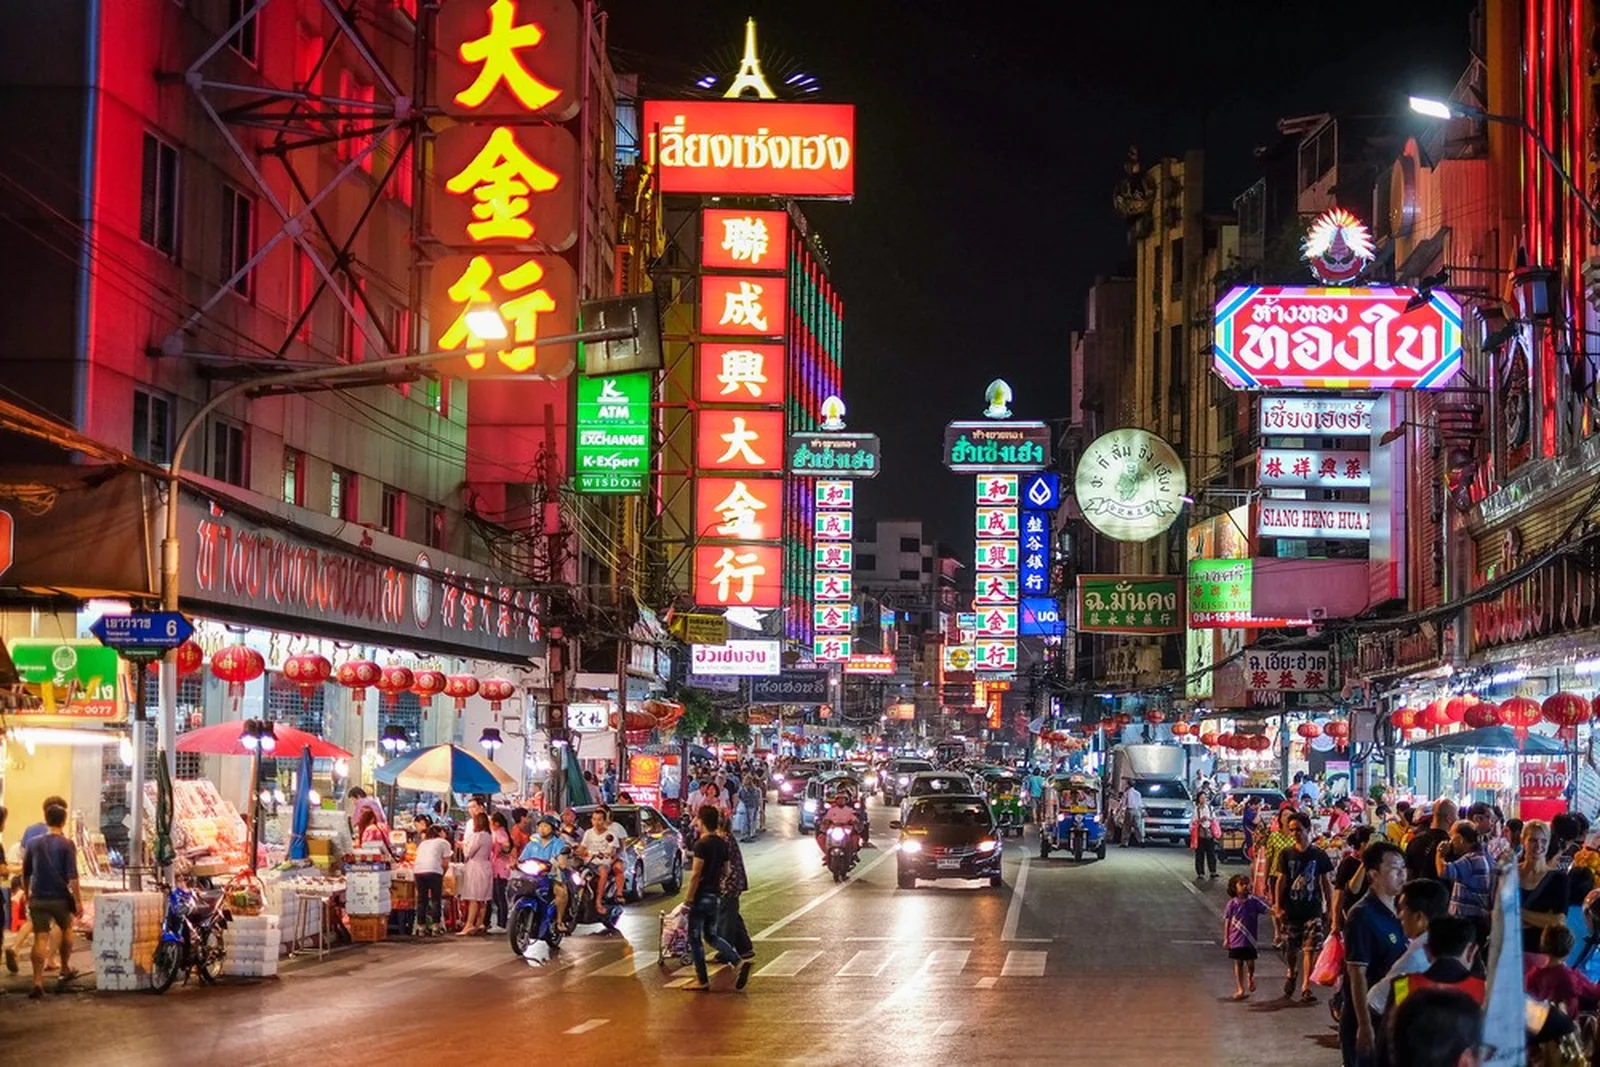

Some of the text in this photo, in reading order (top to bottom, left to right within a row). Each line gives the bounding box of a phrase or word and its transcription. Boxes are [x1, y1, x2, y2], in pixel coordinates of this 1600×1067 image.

[438, 0, 563, 372] 大金行
[1251, 297, 1348, 324] ห้างทอง
[1239, 303, 1437, 371] ทองใบ
[597, 406, 630, 419] ATM
[710, 217, 768, 604] 聯成興大金行
[581, 434, 645, 446] EXCHANGE
[583, 452, 640, 470] K-Expert
[582, 478, 641, 488] WISDOM
[1263, 508, 1300, 528] SIANG
[1302, 509, 1335, 529] HENG
[1338, 511, 1363, 530] HUA
[1085, 580, 1176, 611] ฉ.มั่นคง
[166, 620, 177, 636] 6
